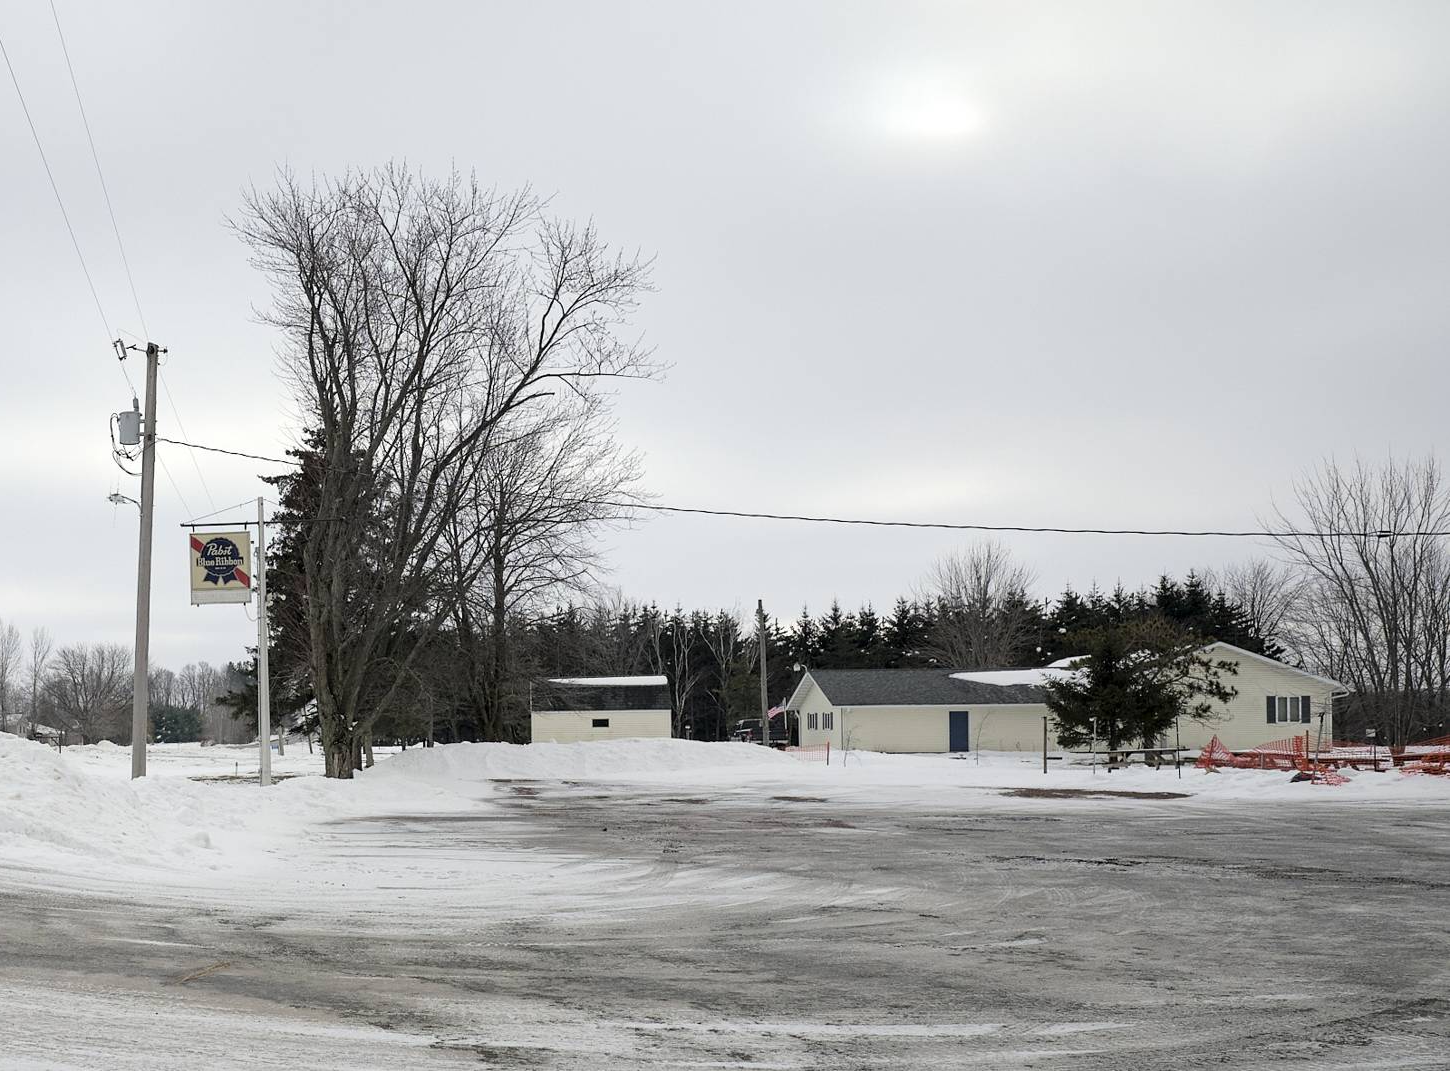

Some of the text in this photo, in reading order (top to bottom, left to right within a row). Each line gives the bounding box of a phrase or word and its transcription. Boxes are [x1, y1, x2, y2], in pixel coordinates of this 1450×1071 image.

[207, 543, 232, 556] Pabst
[198, 557, 243, 566] Blue Ribbon
